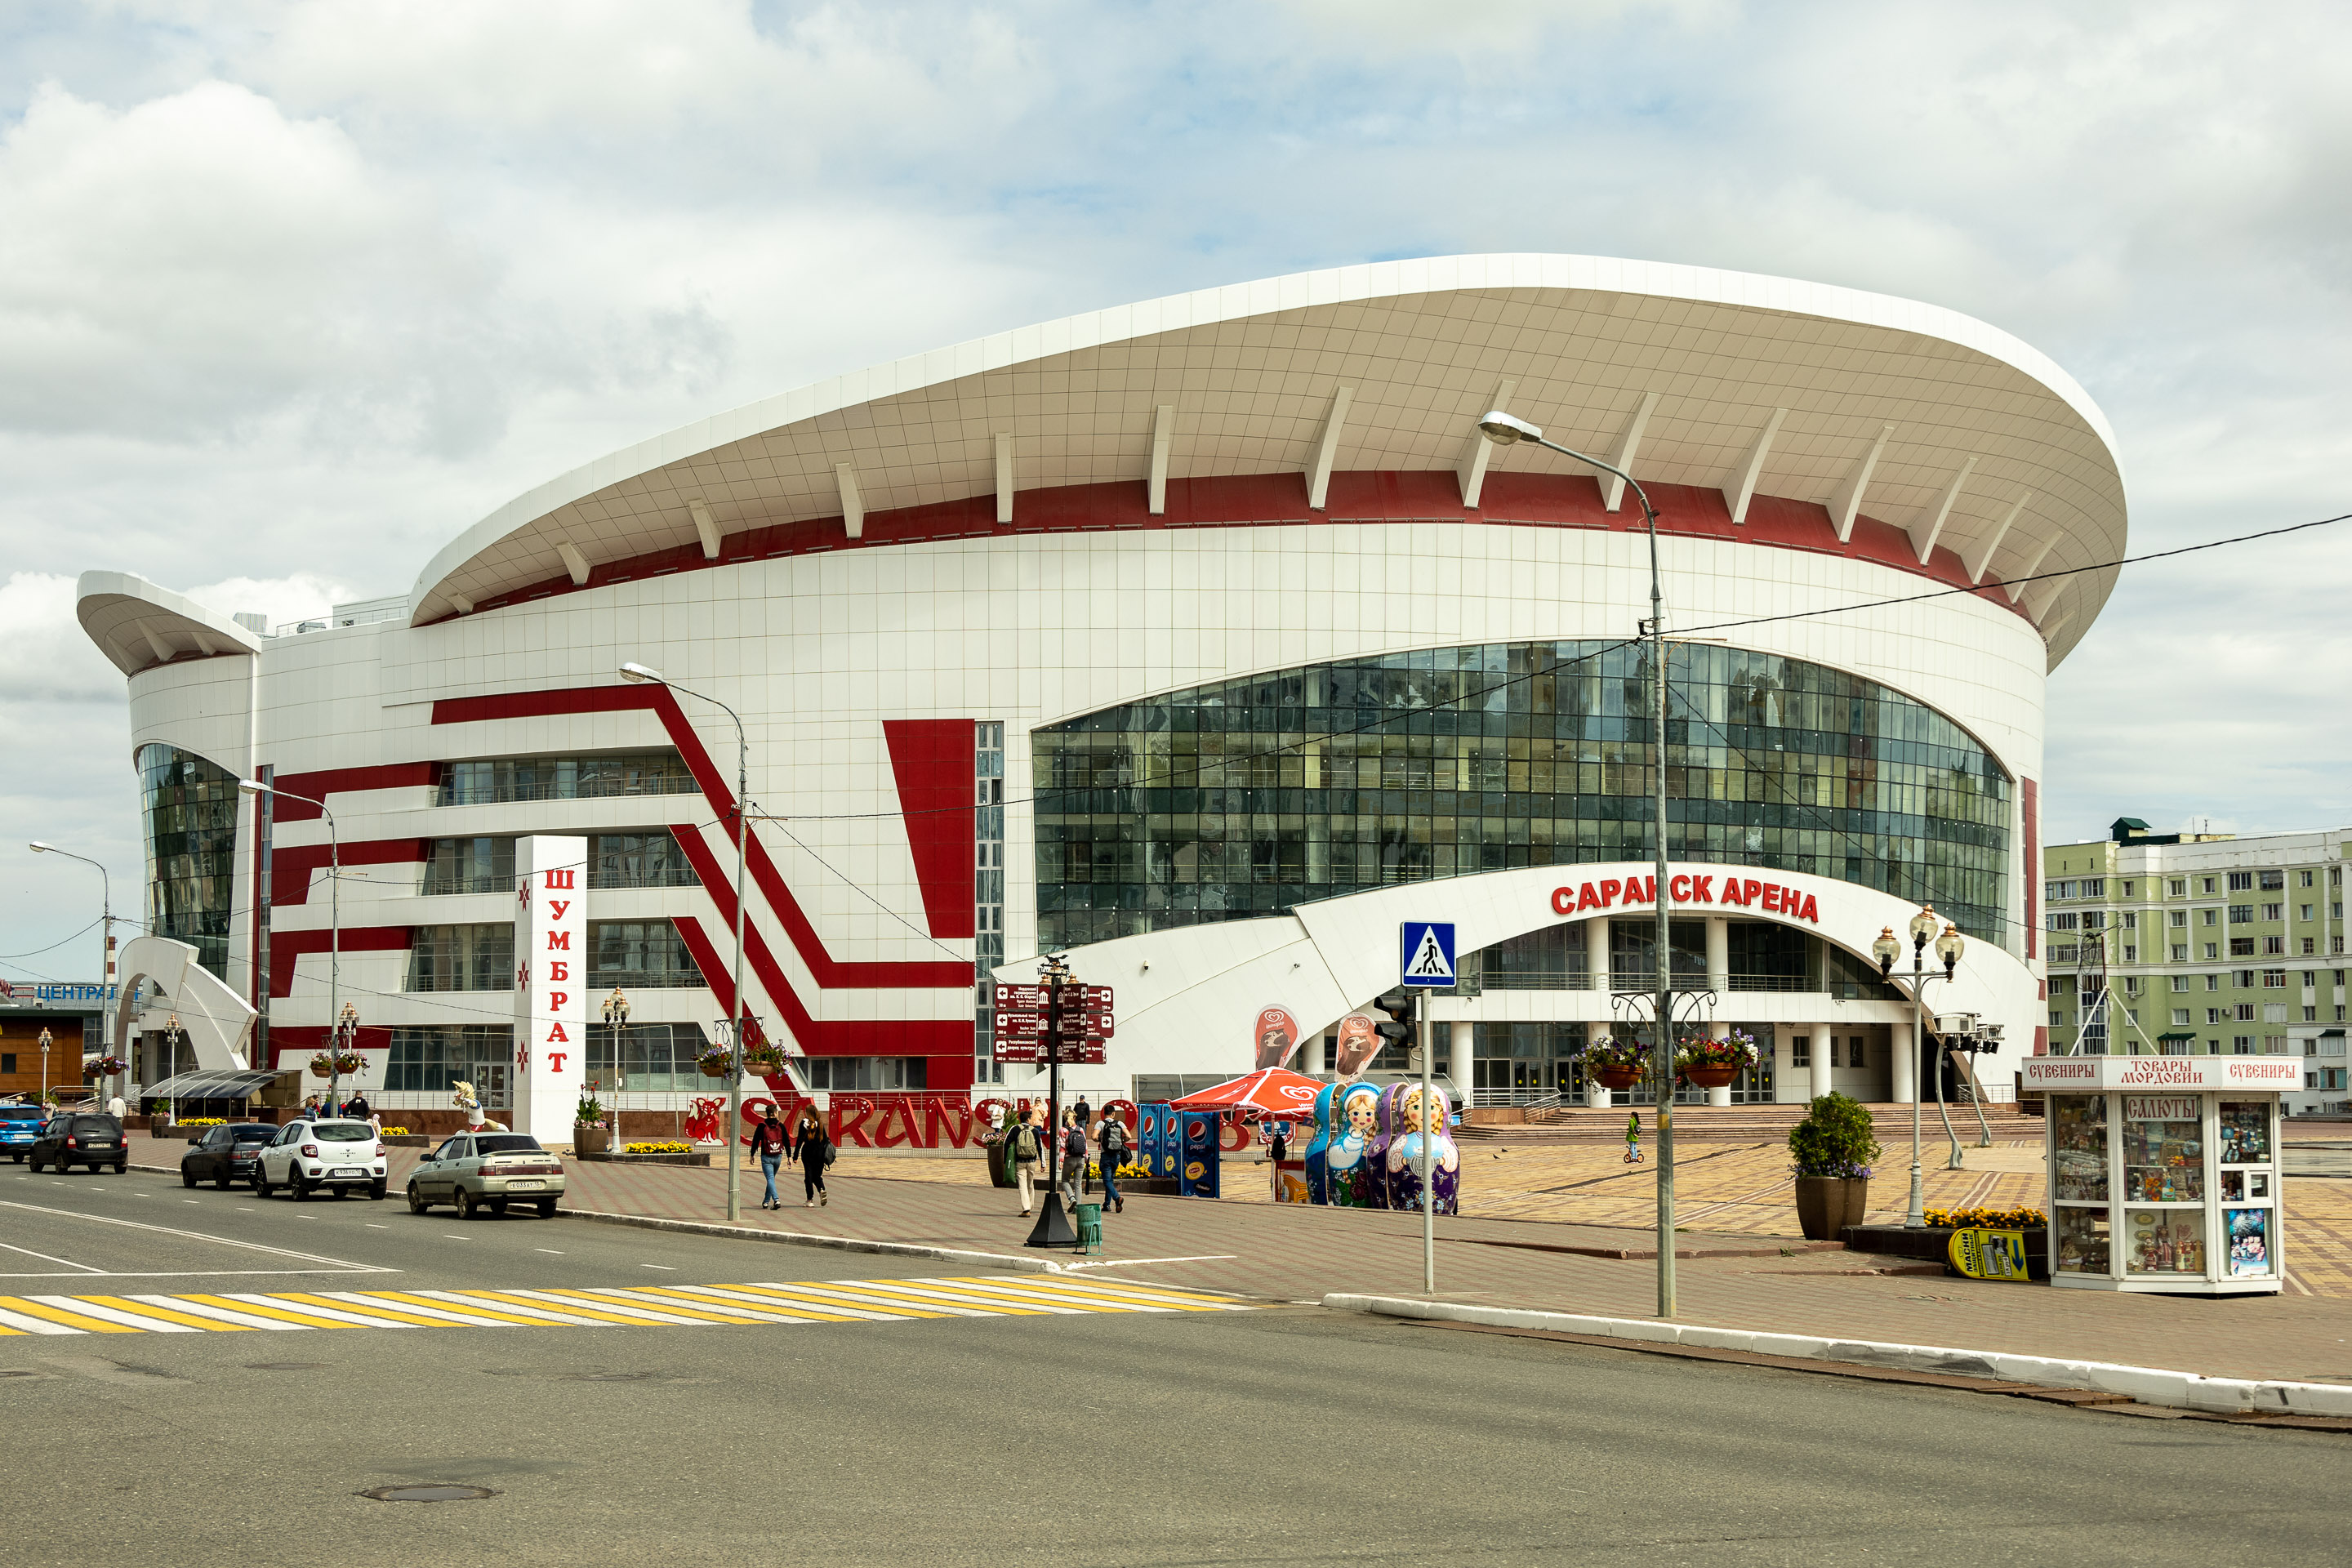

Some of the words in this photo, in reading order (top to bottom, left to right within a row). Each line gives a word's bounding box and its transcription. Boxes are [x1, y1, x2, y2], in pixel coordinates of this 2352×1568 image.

[1721, 877, 1819, 923] АРЕНА
[545, 870, 574, 1073] ШУМБРАТ
[2029, 1064, 2095, 1082] СУВЕНИРЫ
[2131, 1060, 2193, 1072] ТОВАРЫ
[2230, 1063, 2296, 1082] СУВЕНИРЫ
[2121, 1071, 2203, 1085] МОРДОВИИ
[2127, 1097, 2197, 1120] САЛЮТЫ
[1962, 1232, 1973, 1272] МАСКИ
